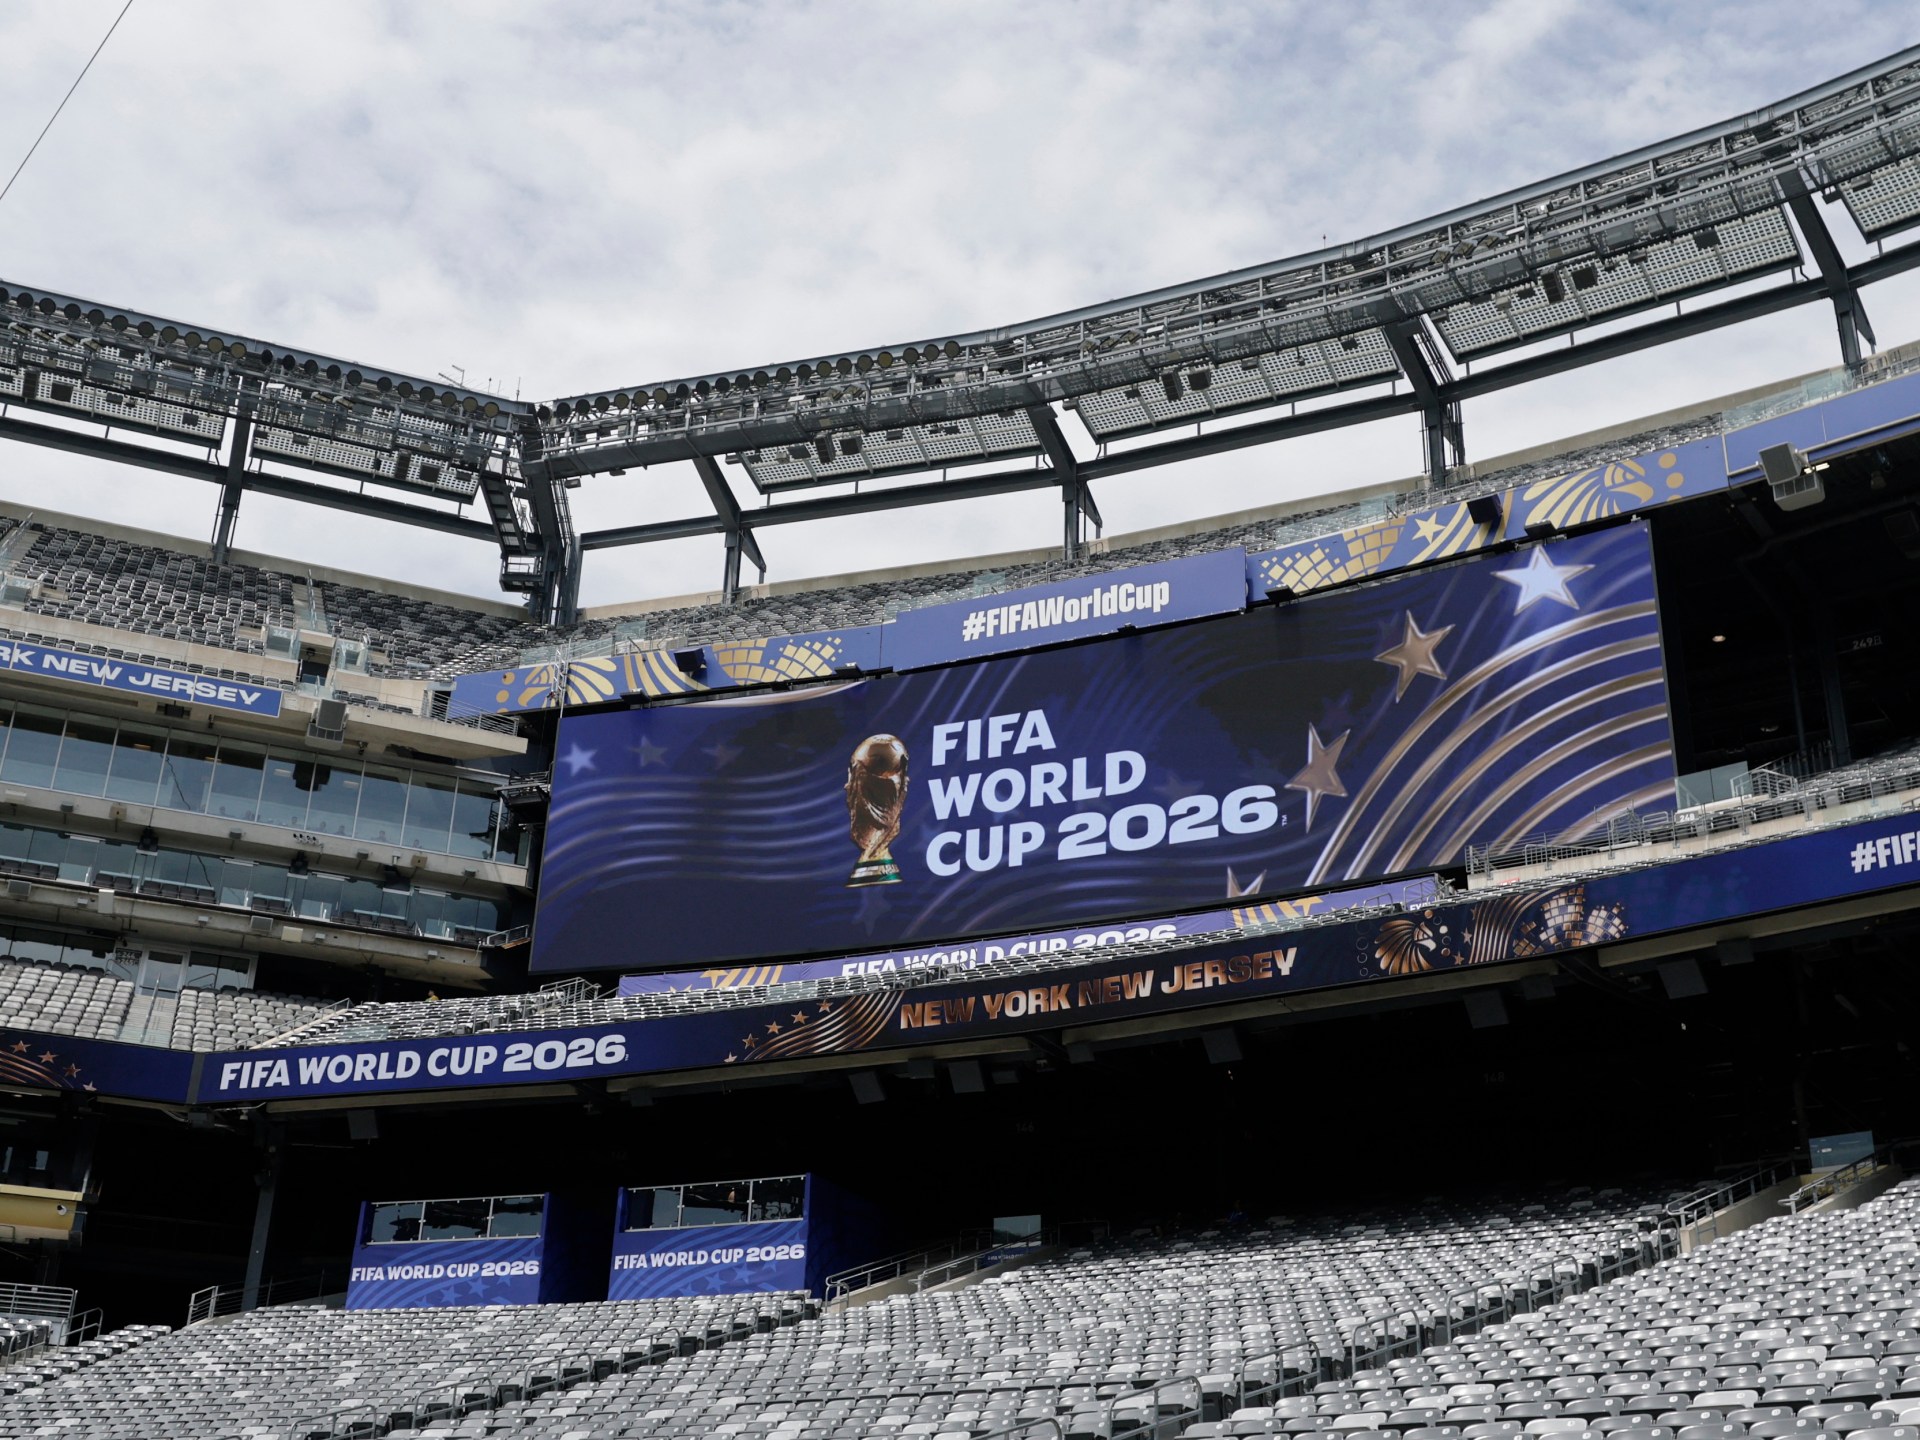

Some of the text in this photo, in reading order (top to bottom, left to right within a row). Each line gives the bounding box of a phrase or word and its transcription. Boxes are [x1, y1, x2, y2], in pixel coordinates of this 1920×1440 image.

[962, 581, 1170, 642] #FIFAWorldCup
[42, 654, 122, 681] NEW
[129, 671, 262, 705] JERSEY
[931, 708, 1057, 767] FIFA
[927, 750, 1148, 821] WORLD
[925, 820, 1046, 877] CUP
[1057, 784, 1279, 861] 2026
[1851, 831, 1920, 873] #FIF
[901, 947, 1298, 1029] NEW YORK NEW JERSEY
[219, 1034, 627, 1090] FIFA WORLD CUP 2026
[351, 1260, 540, 1282] FIFA WORLD CUP 2026
[614, 1244, 805, 1270] FIFA WORLD CUP 2026
